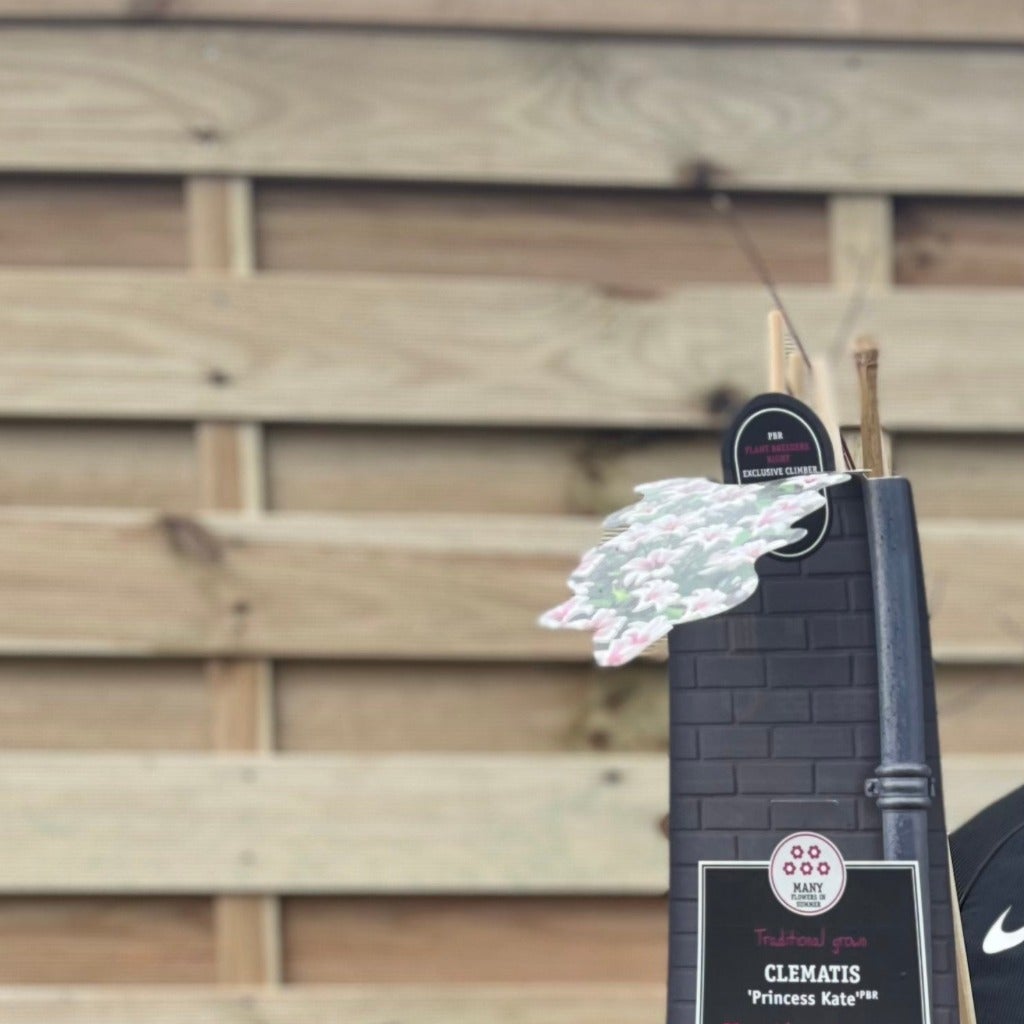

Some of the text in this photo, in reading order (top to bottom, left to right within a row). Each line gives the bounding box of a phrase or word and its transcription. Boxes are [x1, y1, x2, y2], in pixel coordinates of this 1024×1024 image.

[742, 466, 818, 478] EXCLUSIVE CLIMBER
[793, 882, 823, 894] MANY
[754, 928, 867, 955] Traditional grown
[764, 964, 860, 984] CLEMATIS
[747, 989, 815, 1006] 'Princess
